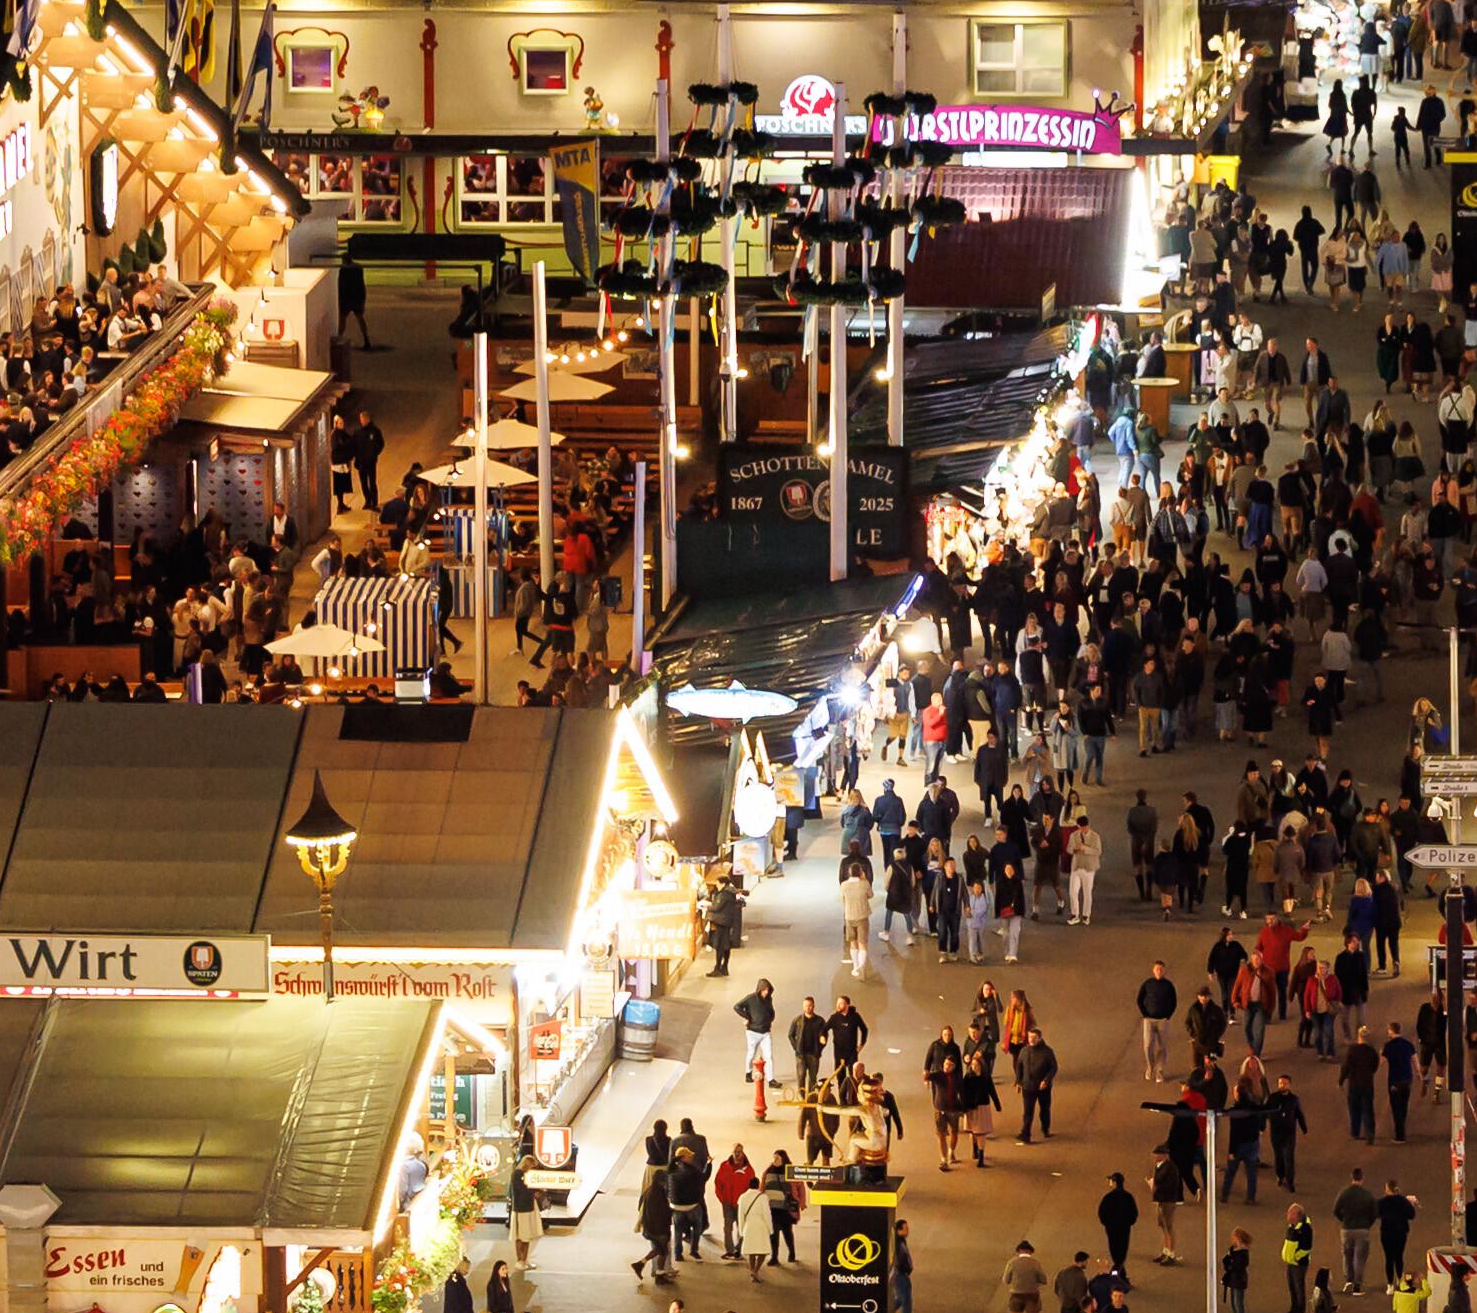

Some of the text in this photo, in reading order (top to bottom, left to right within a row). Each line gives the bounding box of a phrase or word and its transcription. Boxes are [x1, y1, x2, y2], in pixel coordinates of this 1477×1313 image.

[553, 147, 592, 169] MTA
[729, 455, 895, 486] SCHOTTENAMEL
[730, 496, 763, 511] 1867
[859, 497, 894, 512] 2025
[8, 936, 138, 981] Wirt
[46, 1246, 127, 1278] Essen
[140, 1260, 164, 1272] und
[89, 1275, 165, 1287] ein frisches
[828, 1273, 880, 1286] Oktoberfest
